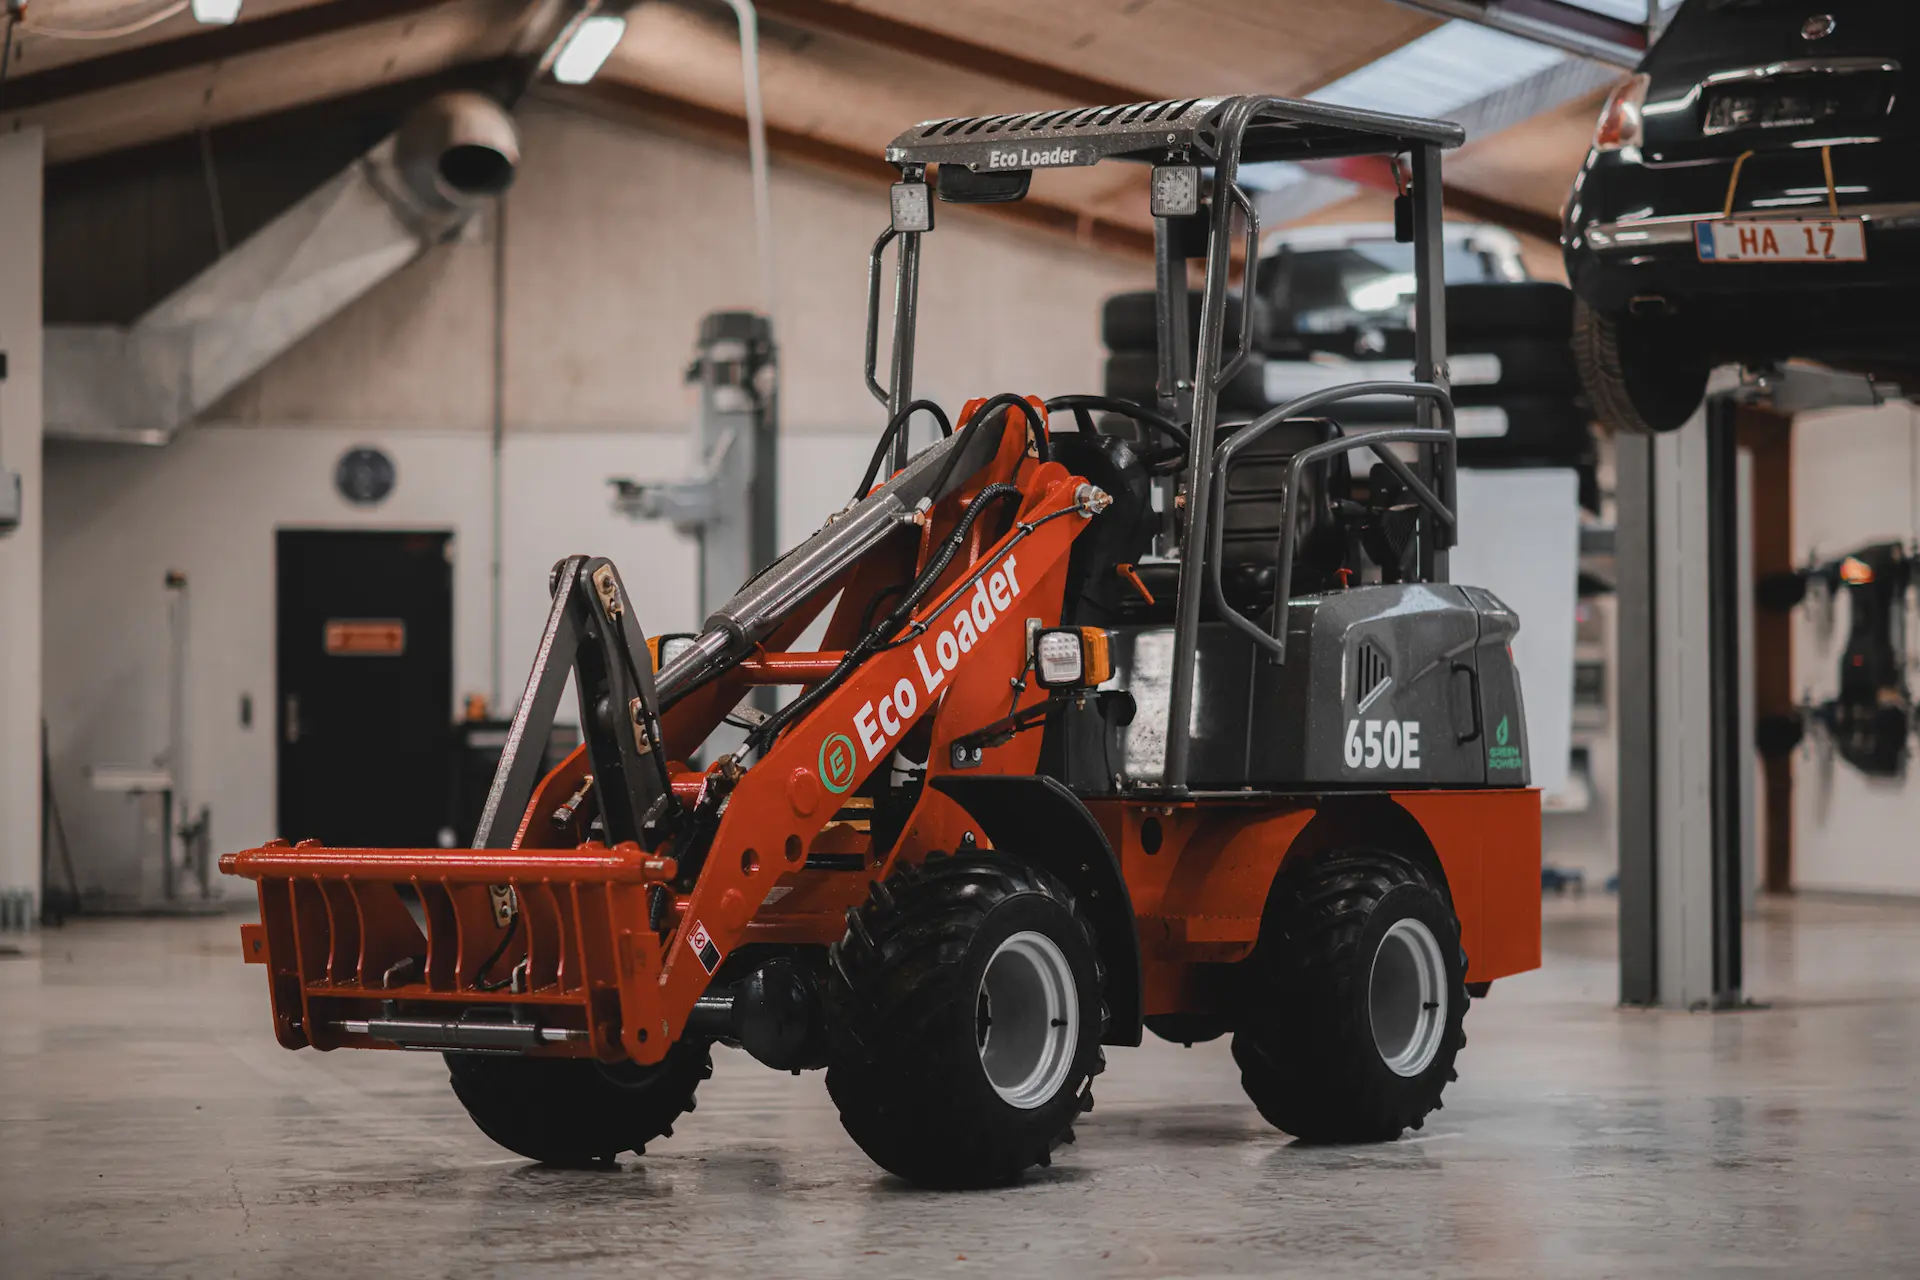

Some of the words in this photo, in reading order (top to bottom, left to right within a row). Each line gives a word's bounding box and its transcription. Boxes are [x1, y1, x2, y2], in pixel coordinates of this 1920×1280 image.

[990, 151, 1018, 168] Eco
[1022, 147, 1077, 166] Loader
[1739, 227, 1779, 255] HA
[1803, 227, 1835, 255] 17
[853, 678, 918, 763] Eco
[913, 554, 1021, 695] Loader
[1344, 719, 1420, 769] 650E
[1489, 747, 1519, 757] GREEN
[1489, 758, 1522, 769] POWER
